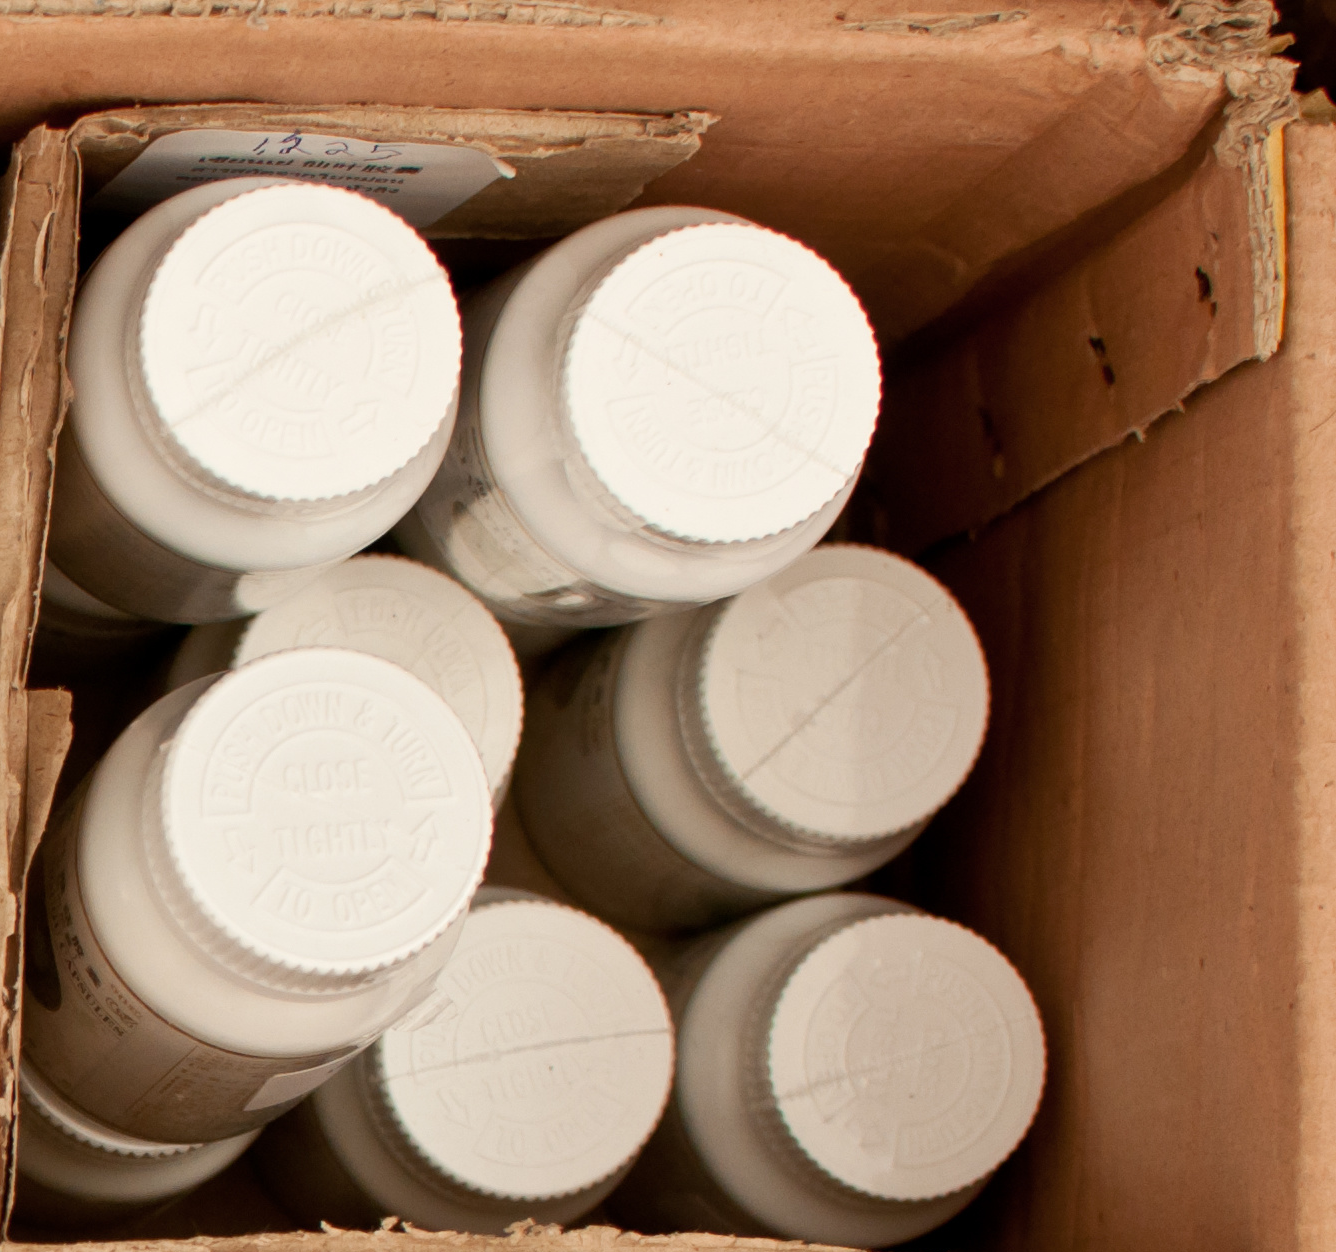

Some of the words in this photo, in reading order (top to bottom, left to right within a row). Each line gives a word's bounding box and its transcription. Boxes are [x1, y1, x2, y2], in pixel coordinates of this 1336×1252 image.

[256, 690, 344, 739] DOWN
[378, 711, 445, 789] TURN
[282, 757, 371, 798] CLOSE
[272, 816, 389, 859] TIGHTLY
[269, 880, 315, 921] TO
[332, 867, 412, 925] OPEN
